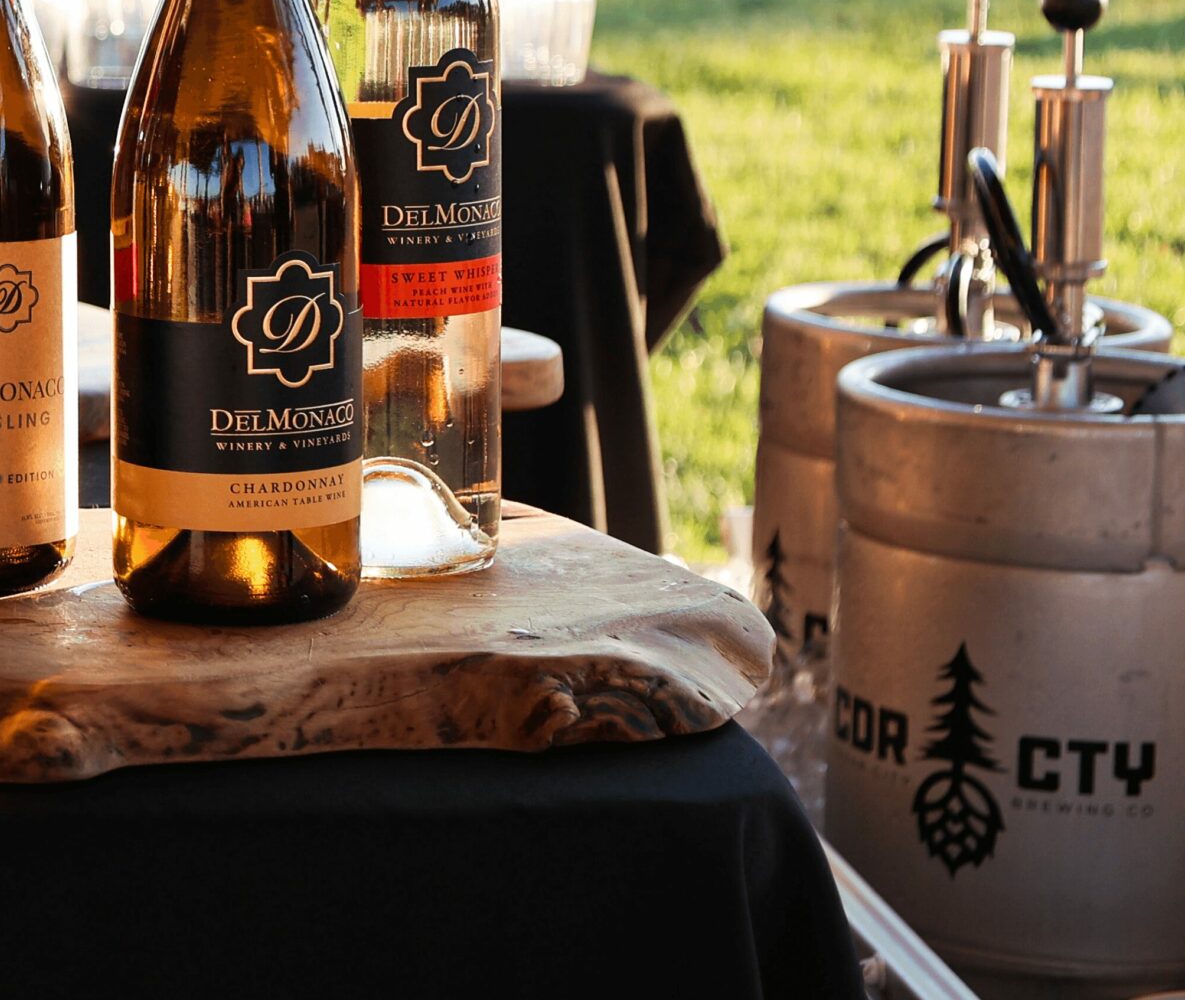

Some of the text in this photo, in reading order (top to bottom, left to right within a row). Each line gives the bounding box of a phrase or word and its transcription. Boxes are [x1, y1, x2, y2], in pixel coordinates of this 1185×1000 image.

[427, 92, 484, 151] D
[387, 235, 440, 245] WINERY
[445, 235, 453, 243] &
[391, 271, 447, 284] SWEET
[393, 298, 444, 307] NATURAL
[448, 294, 480, 304] FLAVOR
[412, 288, 447, 297] PEACH
[450, 285, 473, 294] WINE
[259, 292, 326, 353] D
[209, 403, 354, 432] DELMONACO
[216, 431, 351, 451] WINERY & VINEYARDS
[7, 470, 55, 485] EDITION
[230, 473, 345, 494] CHARDONNAY
[228, 490, 346, 508] AMERICAN TABLE WINE
[1017, 735, 1156, 797] CTY
[1011, 797, 1155, 818] BREWING CO
